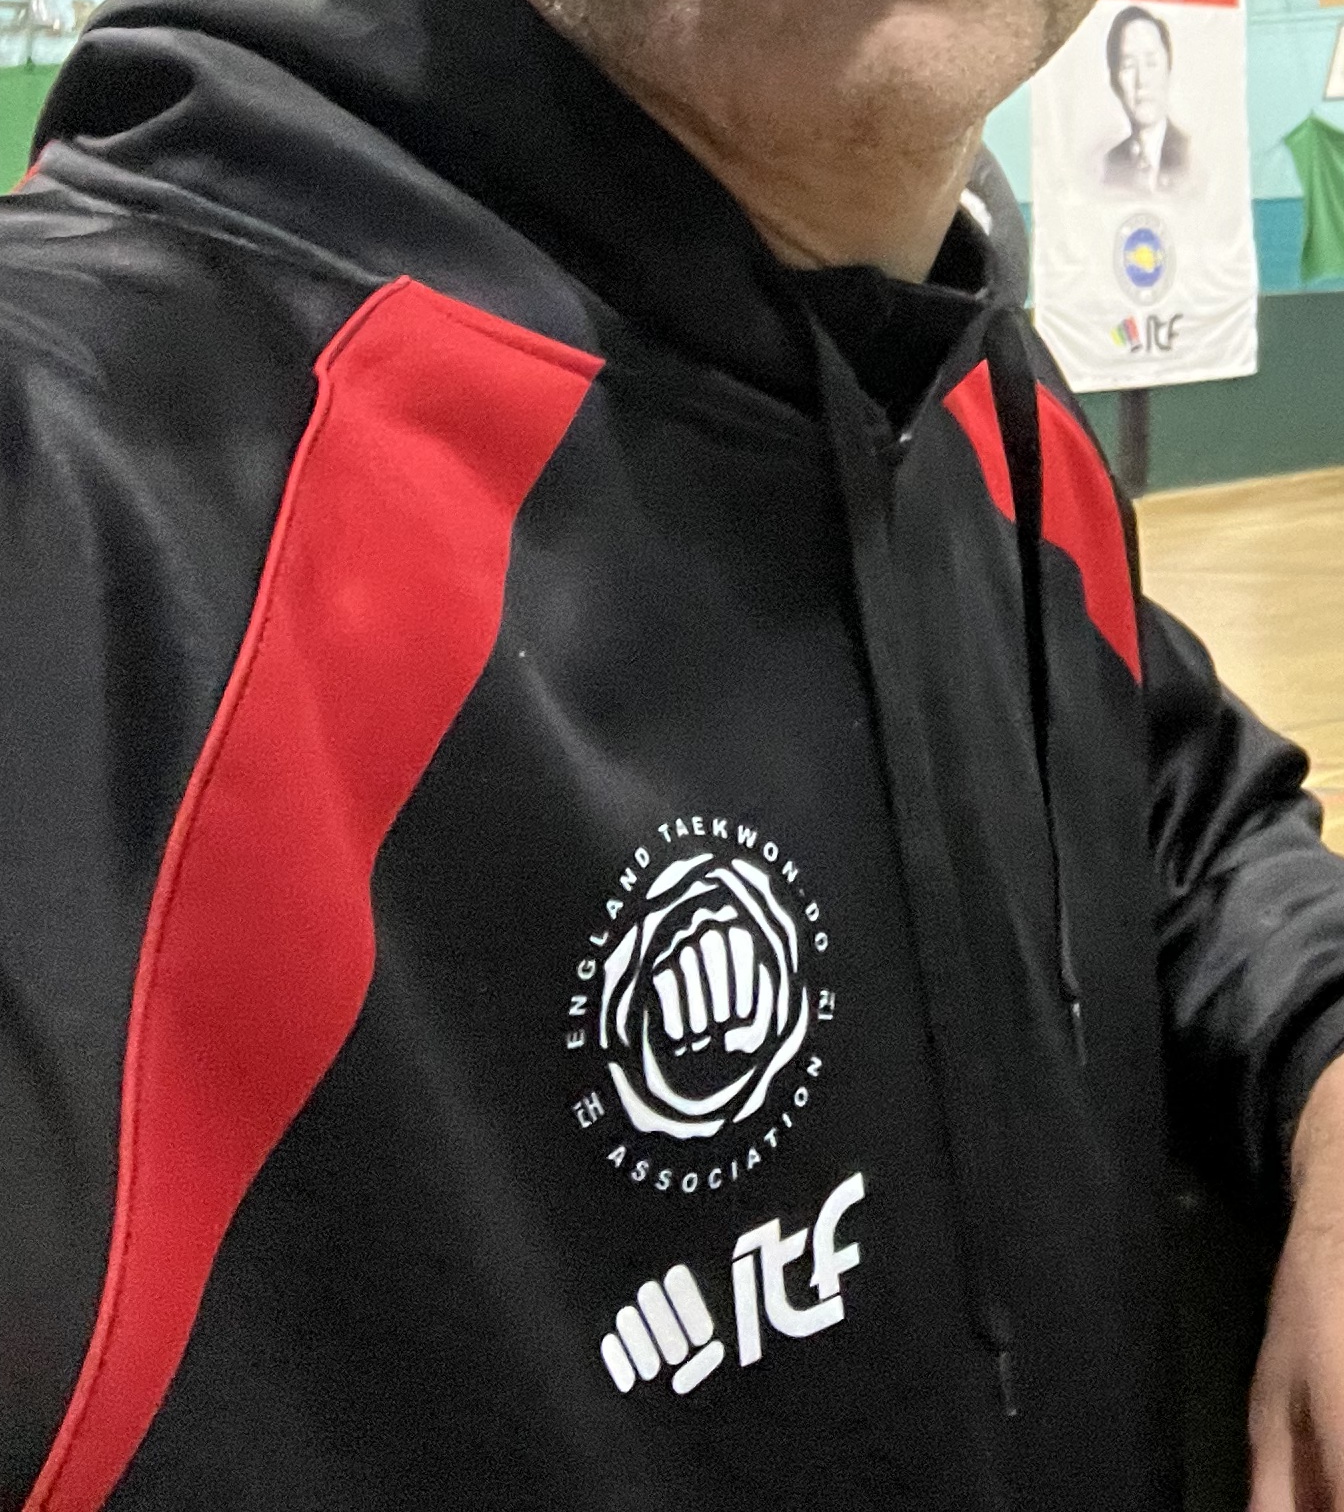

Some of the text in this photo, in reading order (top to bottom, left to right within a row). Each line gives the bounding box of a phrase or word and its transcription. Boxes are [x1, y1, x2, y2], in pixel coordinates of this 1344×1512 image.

[567, 816, 829, 1049] ENGLAND TAEKWON-DO
[606, 1055, 823, 1193] ASSOCIATION
